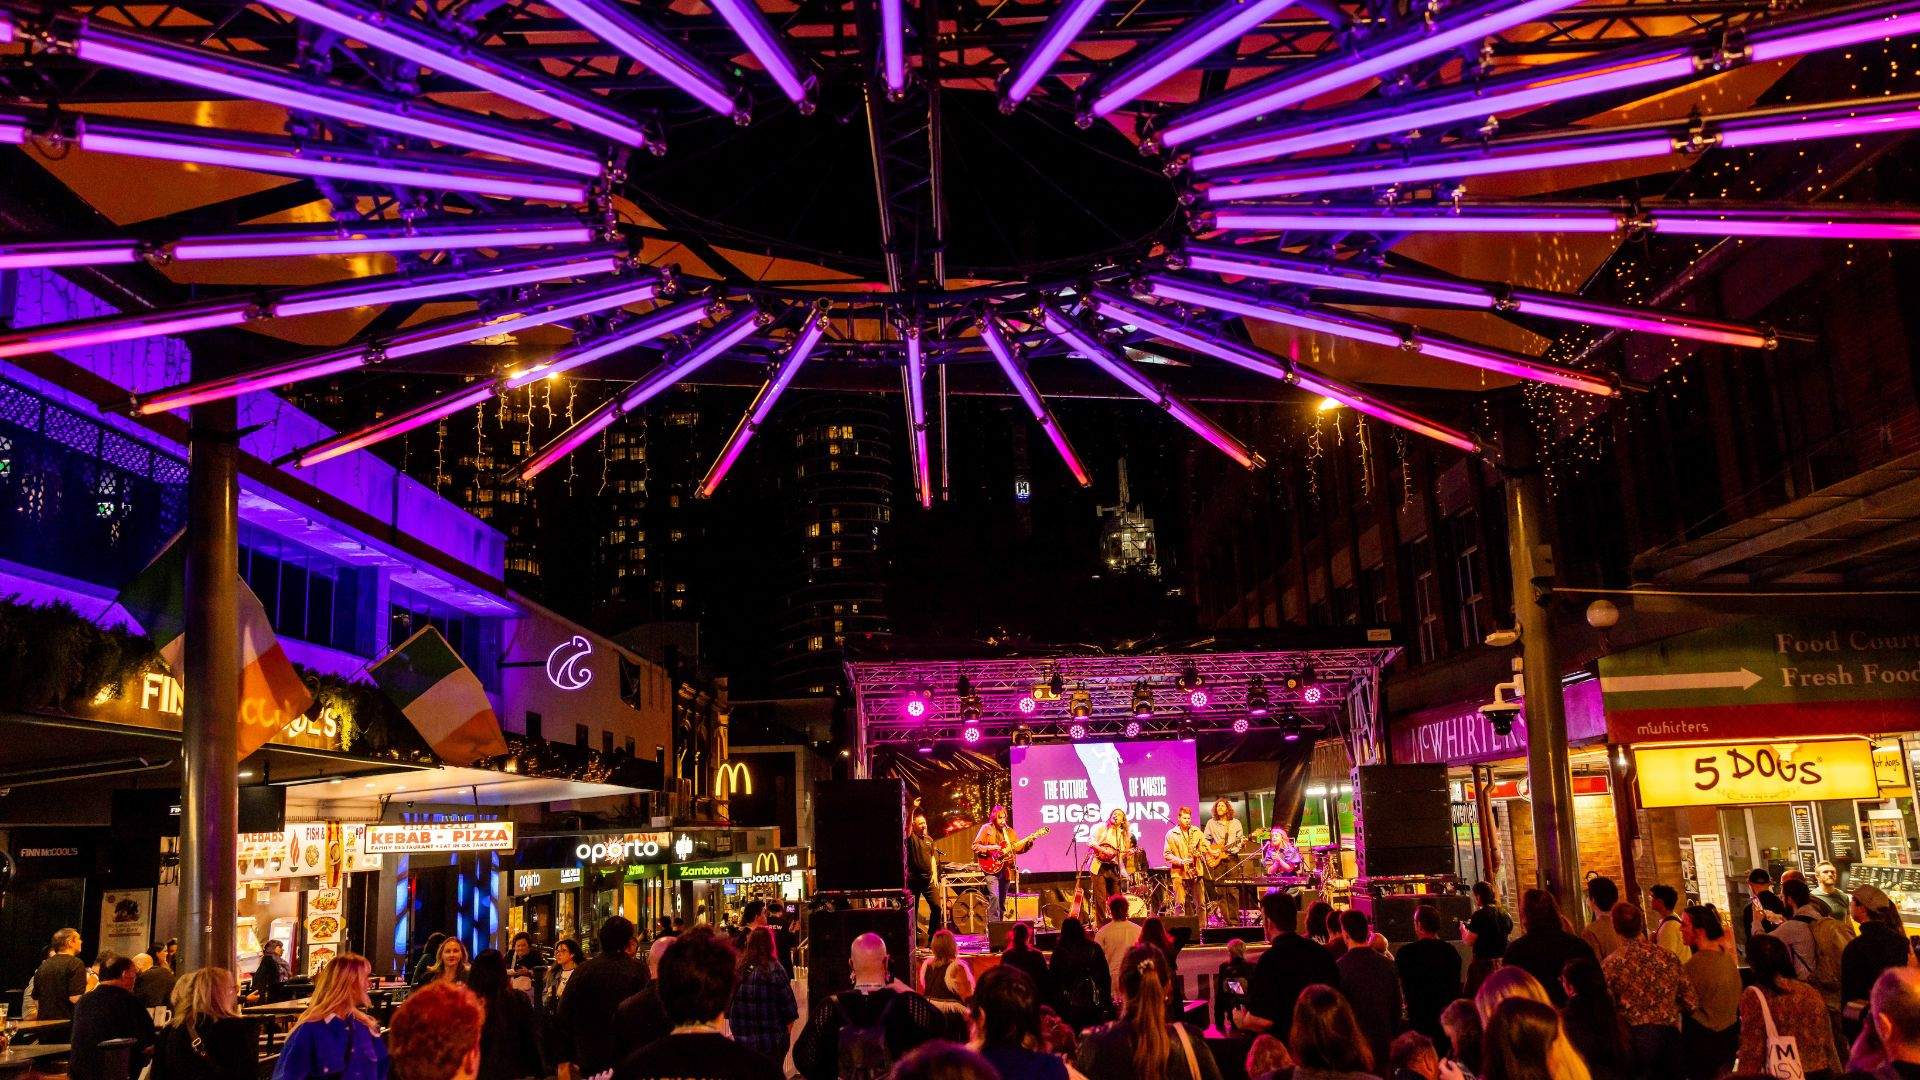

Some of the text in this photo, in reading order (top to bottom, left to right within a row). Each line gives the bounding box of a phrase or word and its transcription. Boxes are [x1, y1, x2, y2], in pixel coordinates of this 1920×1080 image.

[1775, 631, 1840, 653] Food
[1782, 664, 1854, 688] Fresh
[1694, 748, 1823, 790] 5 DOGS
[1044, 776, 1167, 799] THE FUTURE OF MUSIC
[243, 831, 284, 843] KEBABS
[306, 827, 320, 840] FISH
[371, 831, 432, 844] KEBAB
[452, 829, 508, 842] PIZZA
[20, 849, 41, 857] FINN
[576, 838, 659, 863] oporto
[680, 865, 730, 876] Zambrero
